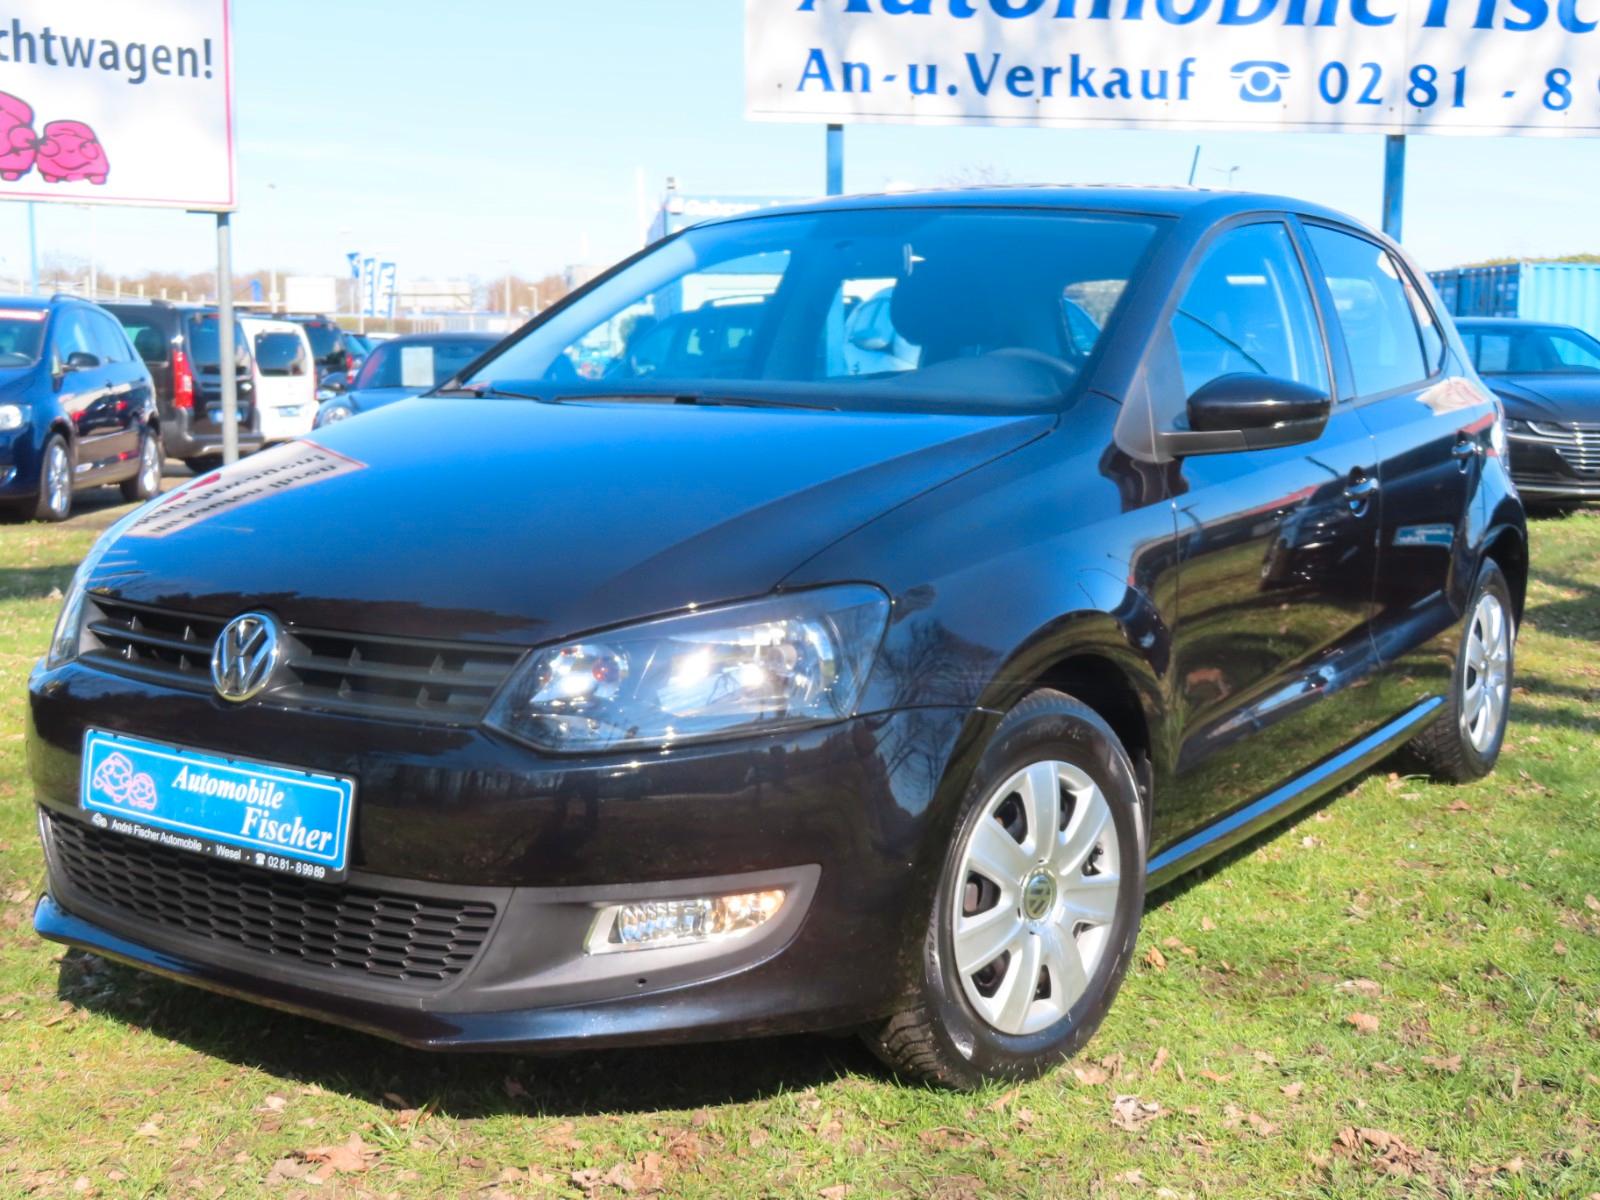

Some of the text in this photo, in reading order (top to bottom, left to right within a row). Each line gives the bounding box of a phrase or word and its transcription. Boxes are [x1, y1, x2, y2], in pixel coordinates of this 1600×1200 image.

[171, 765, 285, 809] Automobile
[133, 824, 160, 840] Fischer
[160, 832, 202, 852] Automobile
[216, 844, 242, 860] Wesel
[240, 806, 333, 852] Fischer
